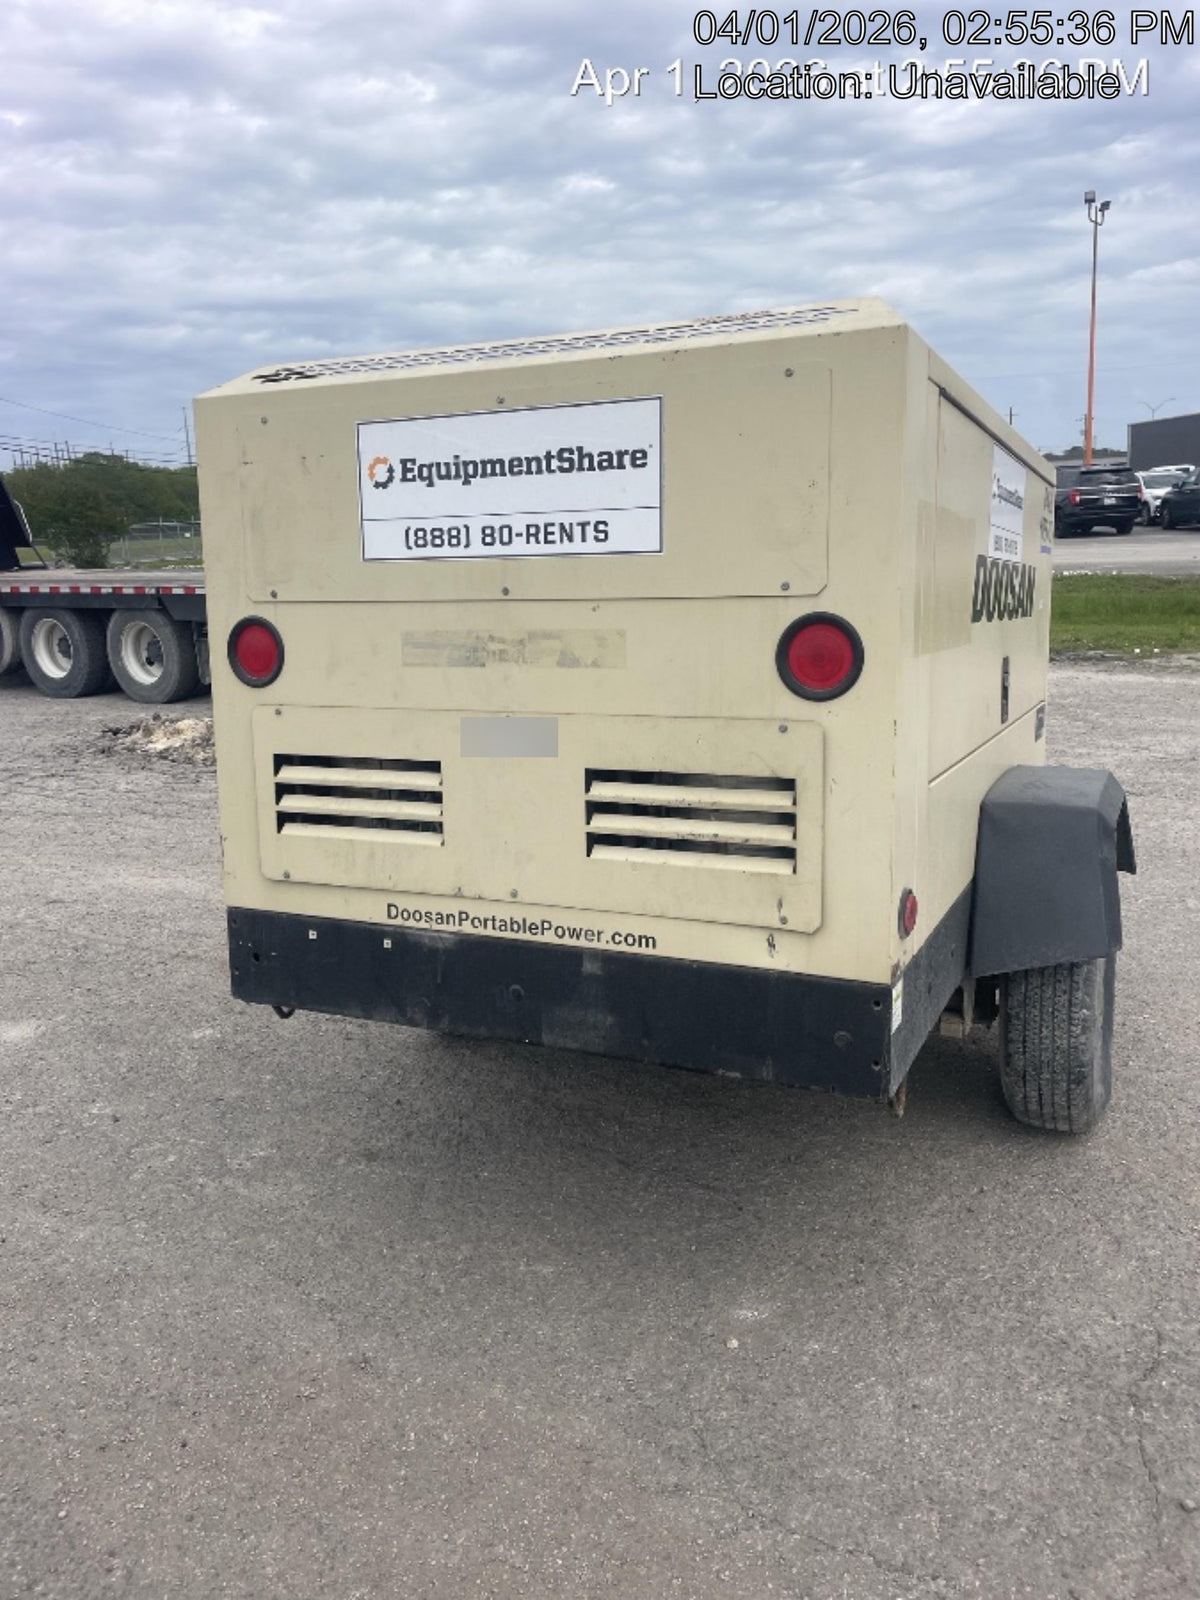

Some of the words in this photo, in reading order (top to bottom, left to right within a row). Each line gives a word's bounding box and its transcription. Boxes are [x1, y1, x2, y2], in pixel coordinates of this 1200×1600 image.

[400, 446, 649, 487] EquipmentShare
[404, 526, 471, 549] (888)
[481, 520, 609, 546] 80-RENTS
[971, 554, 1036, 623] DOOSAN
[387, 903, 657, 949] DoosanPortablePower.com
